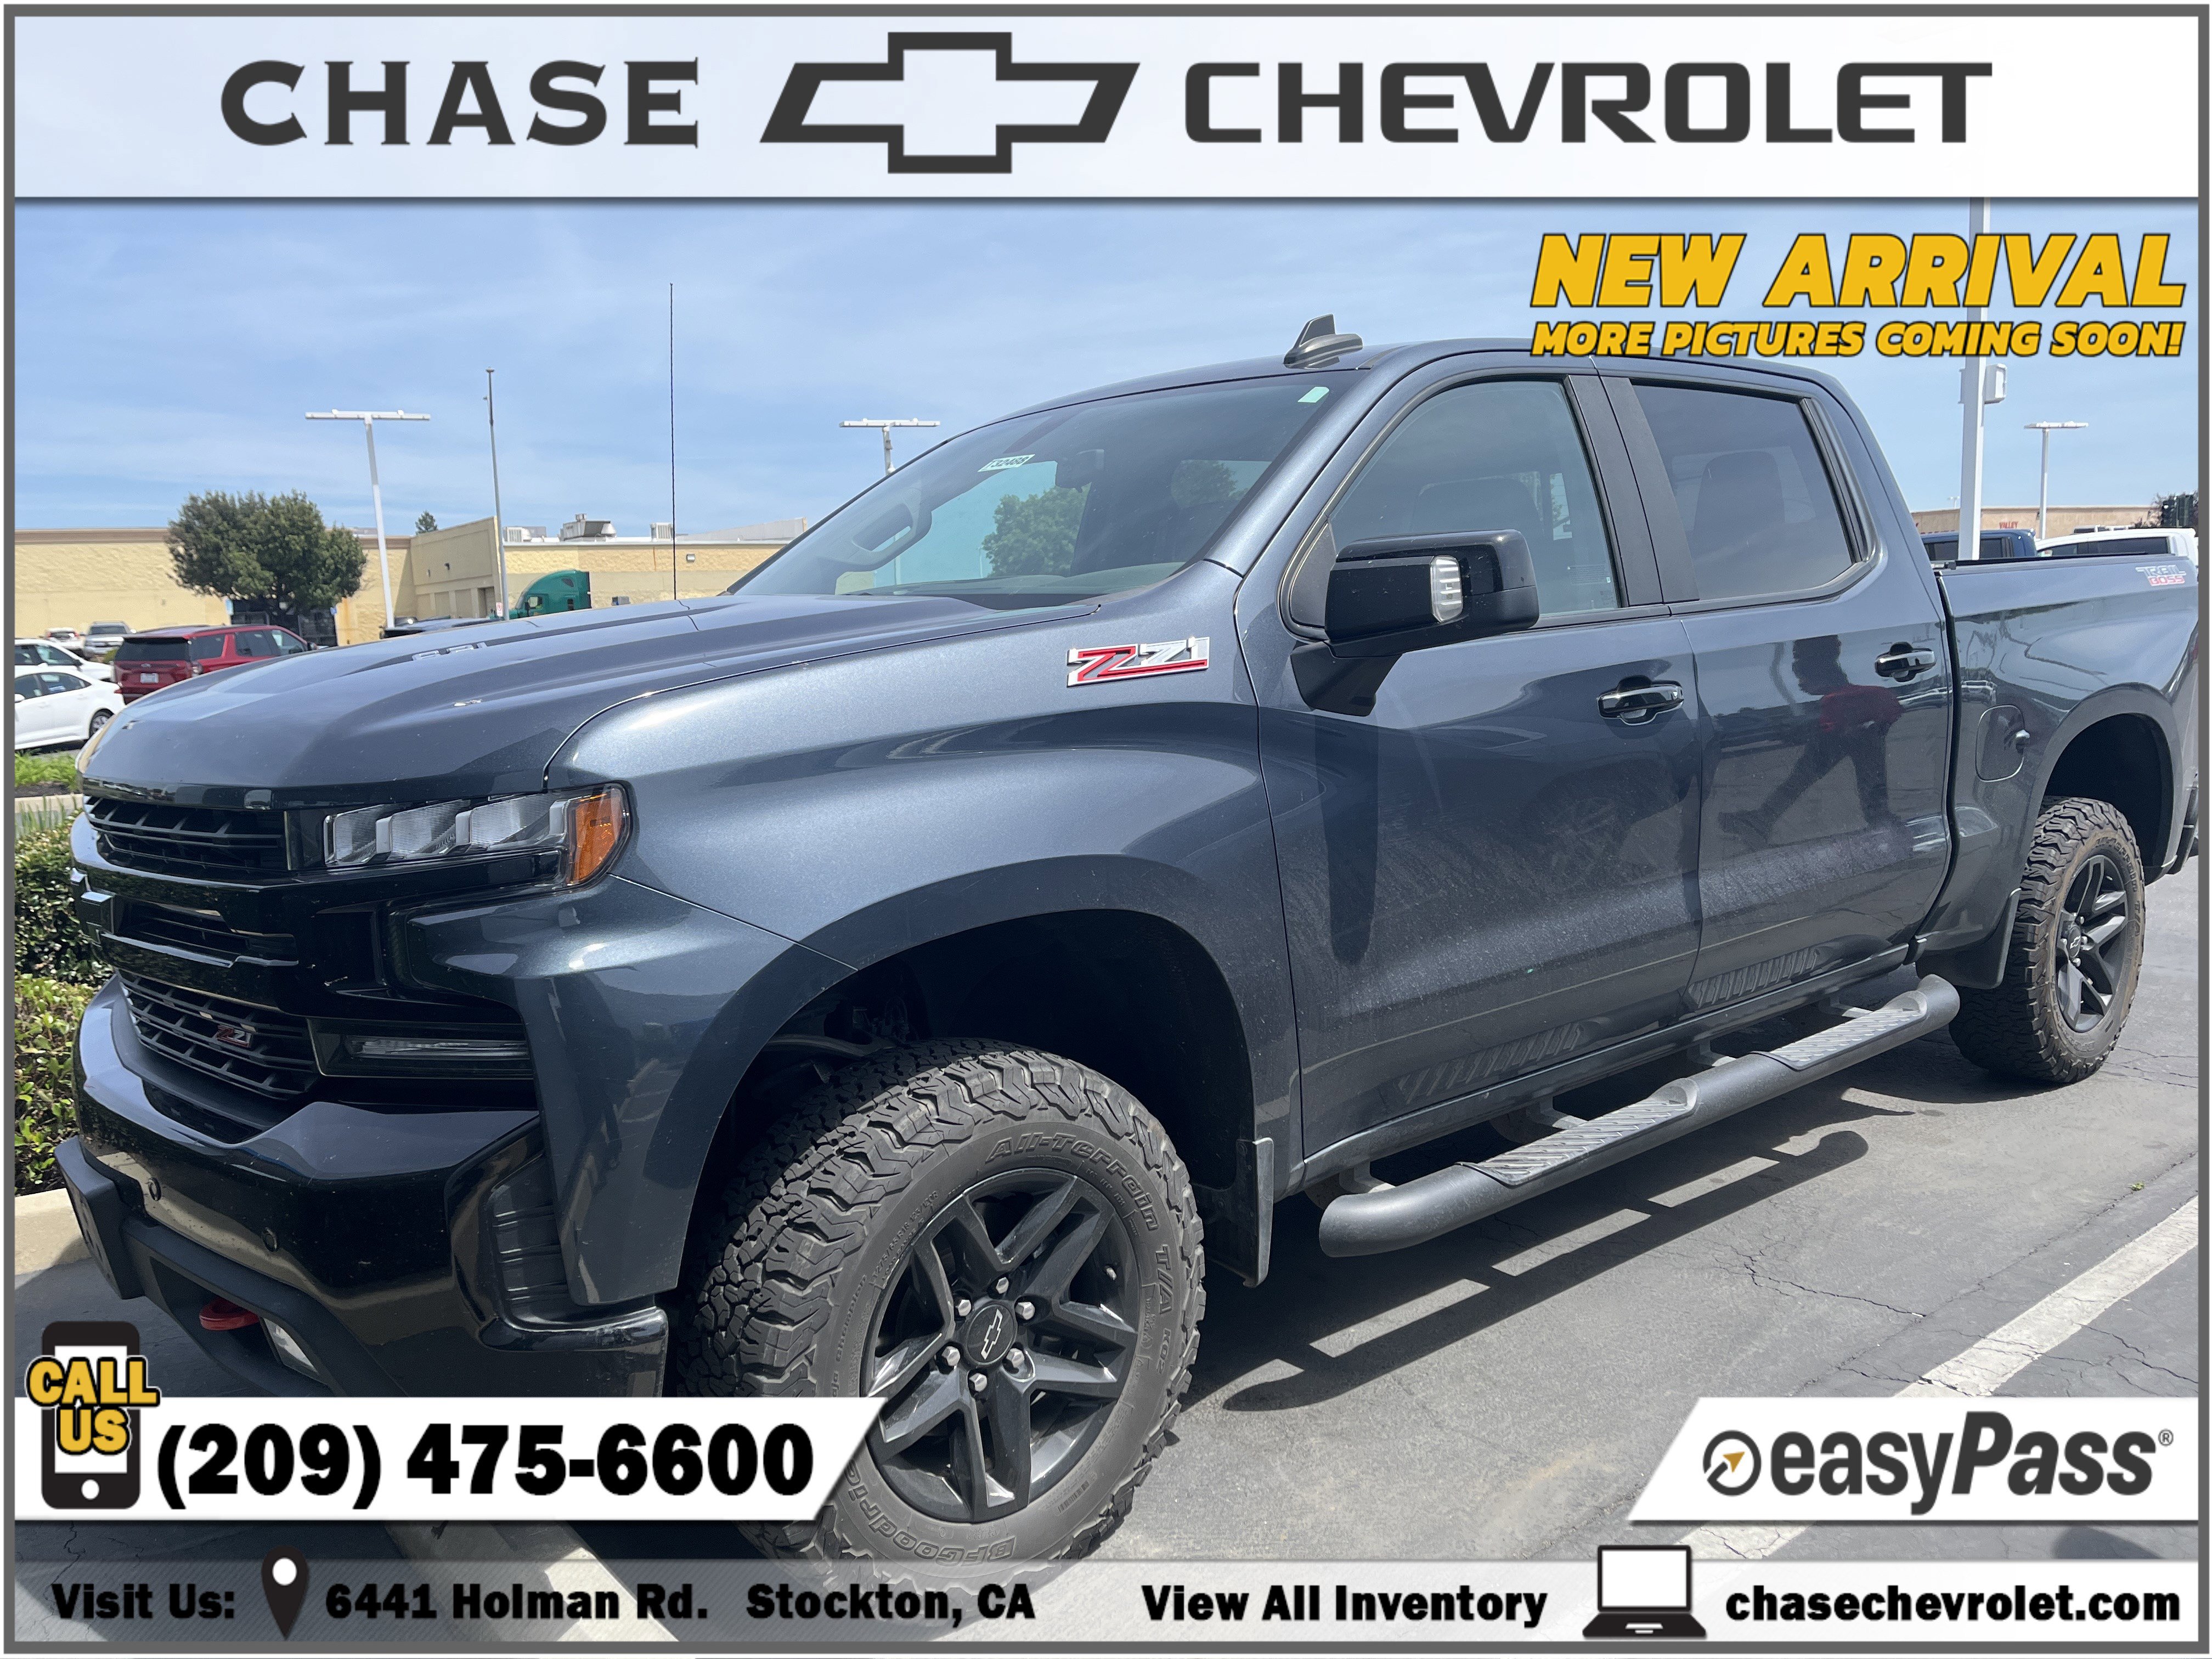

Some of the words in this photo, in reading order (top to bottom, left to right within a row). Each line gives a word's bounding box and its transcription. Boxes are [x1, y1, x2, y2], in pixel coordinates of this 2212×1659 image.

[2148, 575, 2185, 586] BOSS
[1066, 636, 1210, 687] Z71
[217, 1025, 252, 1047] Z71
[985, 1132, 1159, 1231] All-Terrain
[1155, 1244, 1174, 1314] T/A
[844, 1460, 1015, 1567] BFGoodric
